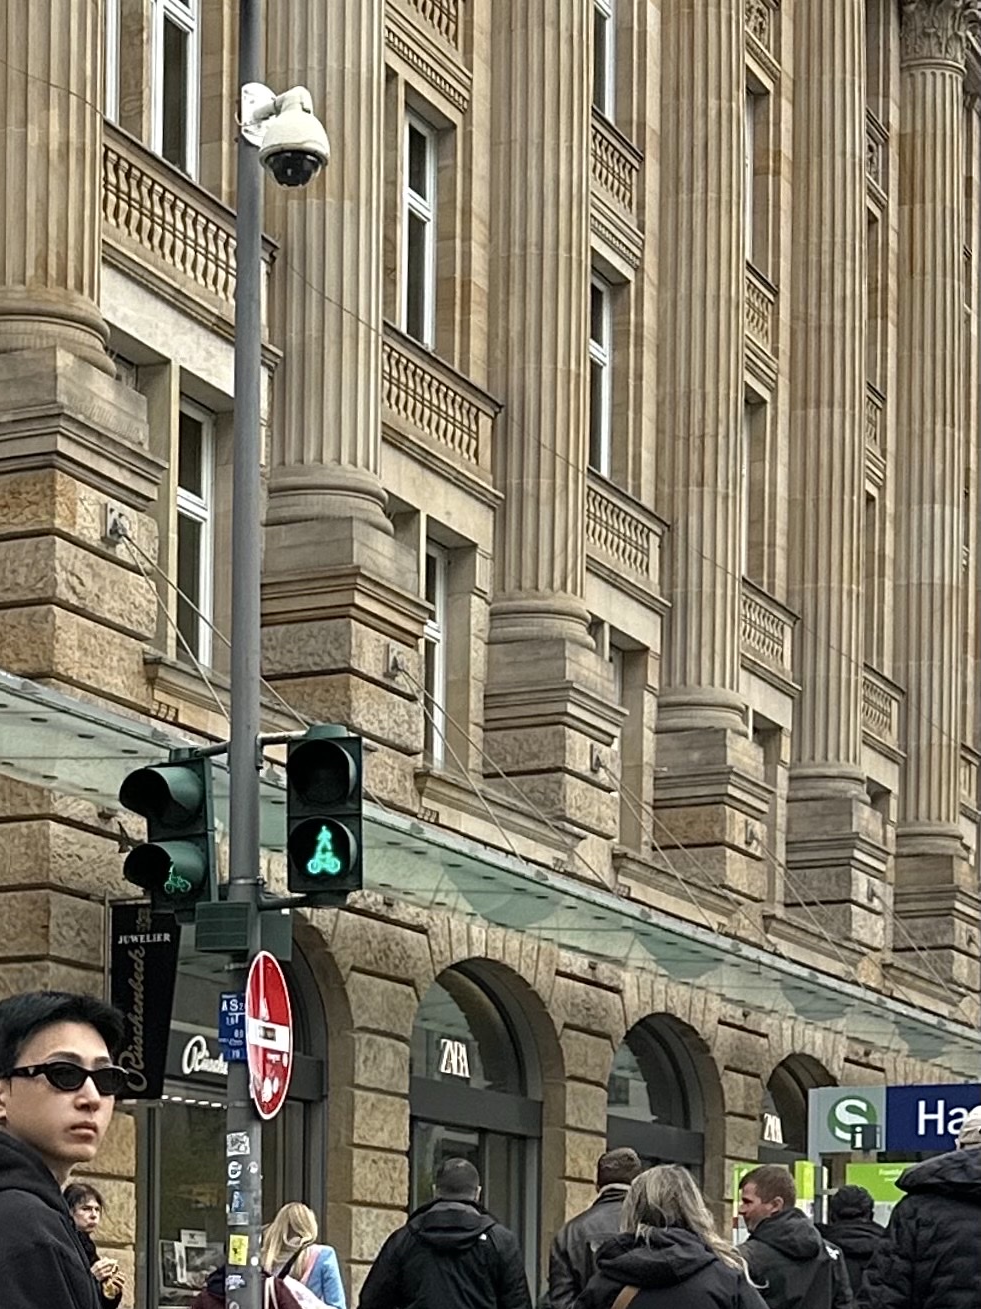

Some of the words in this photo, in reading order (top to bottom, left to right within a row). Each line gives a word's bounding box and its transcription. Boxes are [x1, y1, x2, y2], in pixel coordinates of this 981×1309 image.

[118, 933, 171, 944] JUWELIER
[118, 946, 148, 1092] Rüschenbeck
[441, 1039, 471, 1078] ZARA
